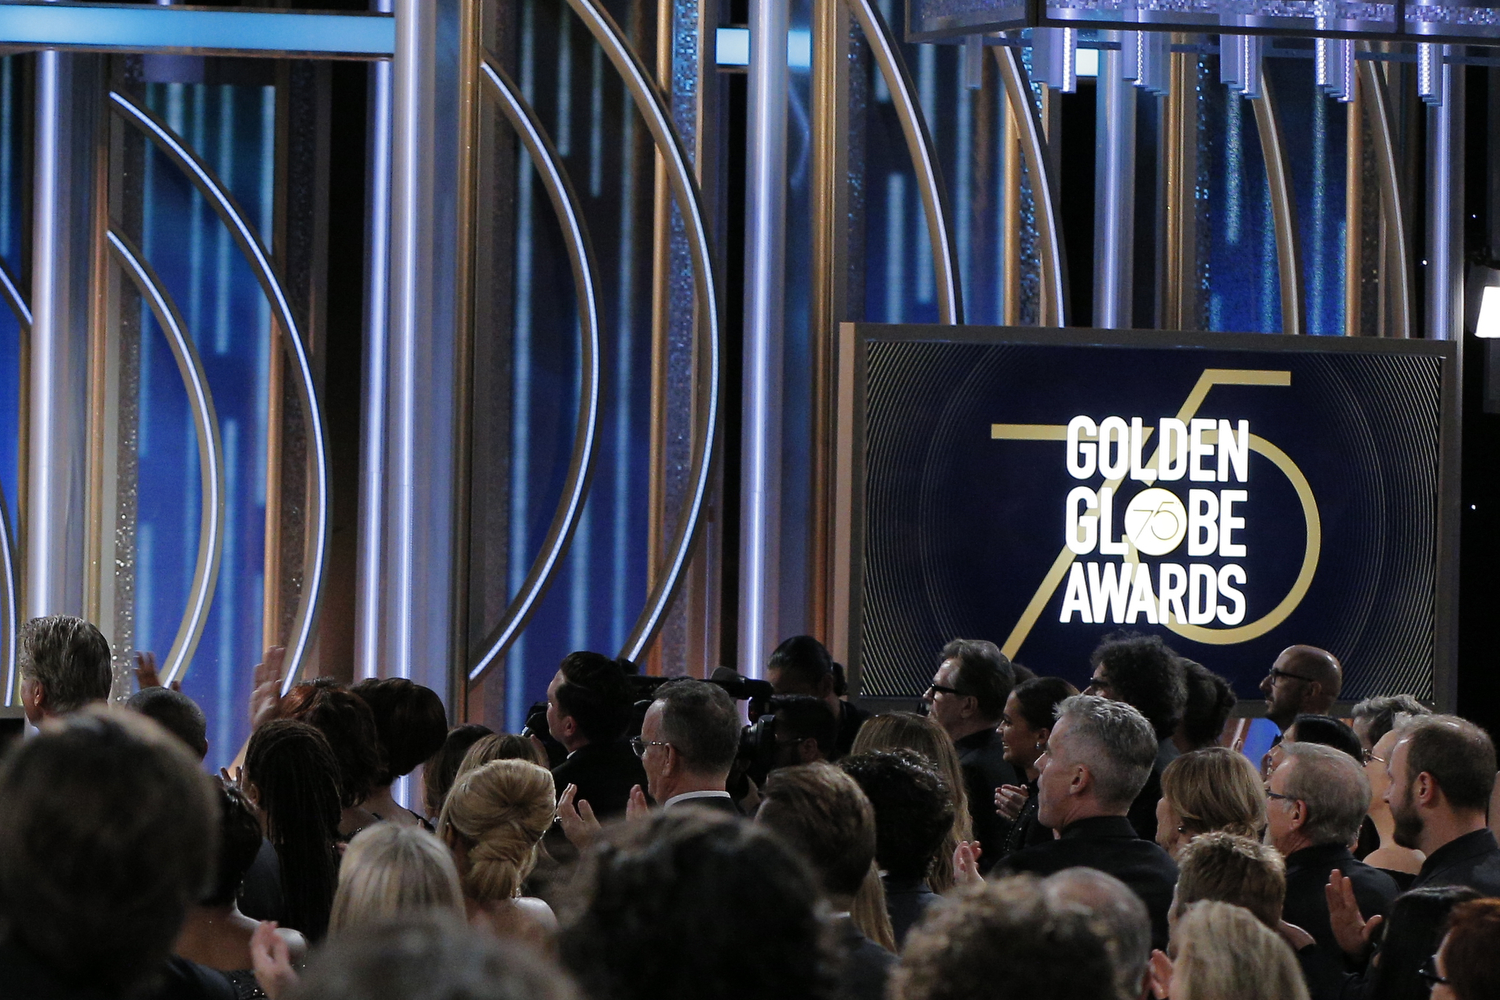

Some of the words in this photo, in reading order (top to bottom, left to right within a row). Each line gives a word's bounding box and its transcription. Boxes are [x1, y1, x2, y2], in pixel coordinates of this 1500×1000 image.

[1065, 415, 1249, 483] GOLDEN
[1064, 486, 1248, 557] GLOBE
[1132, 501, 1180, 541] 75
[1058, 561, 1247, 626] AWARDS
